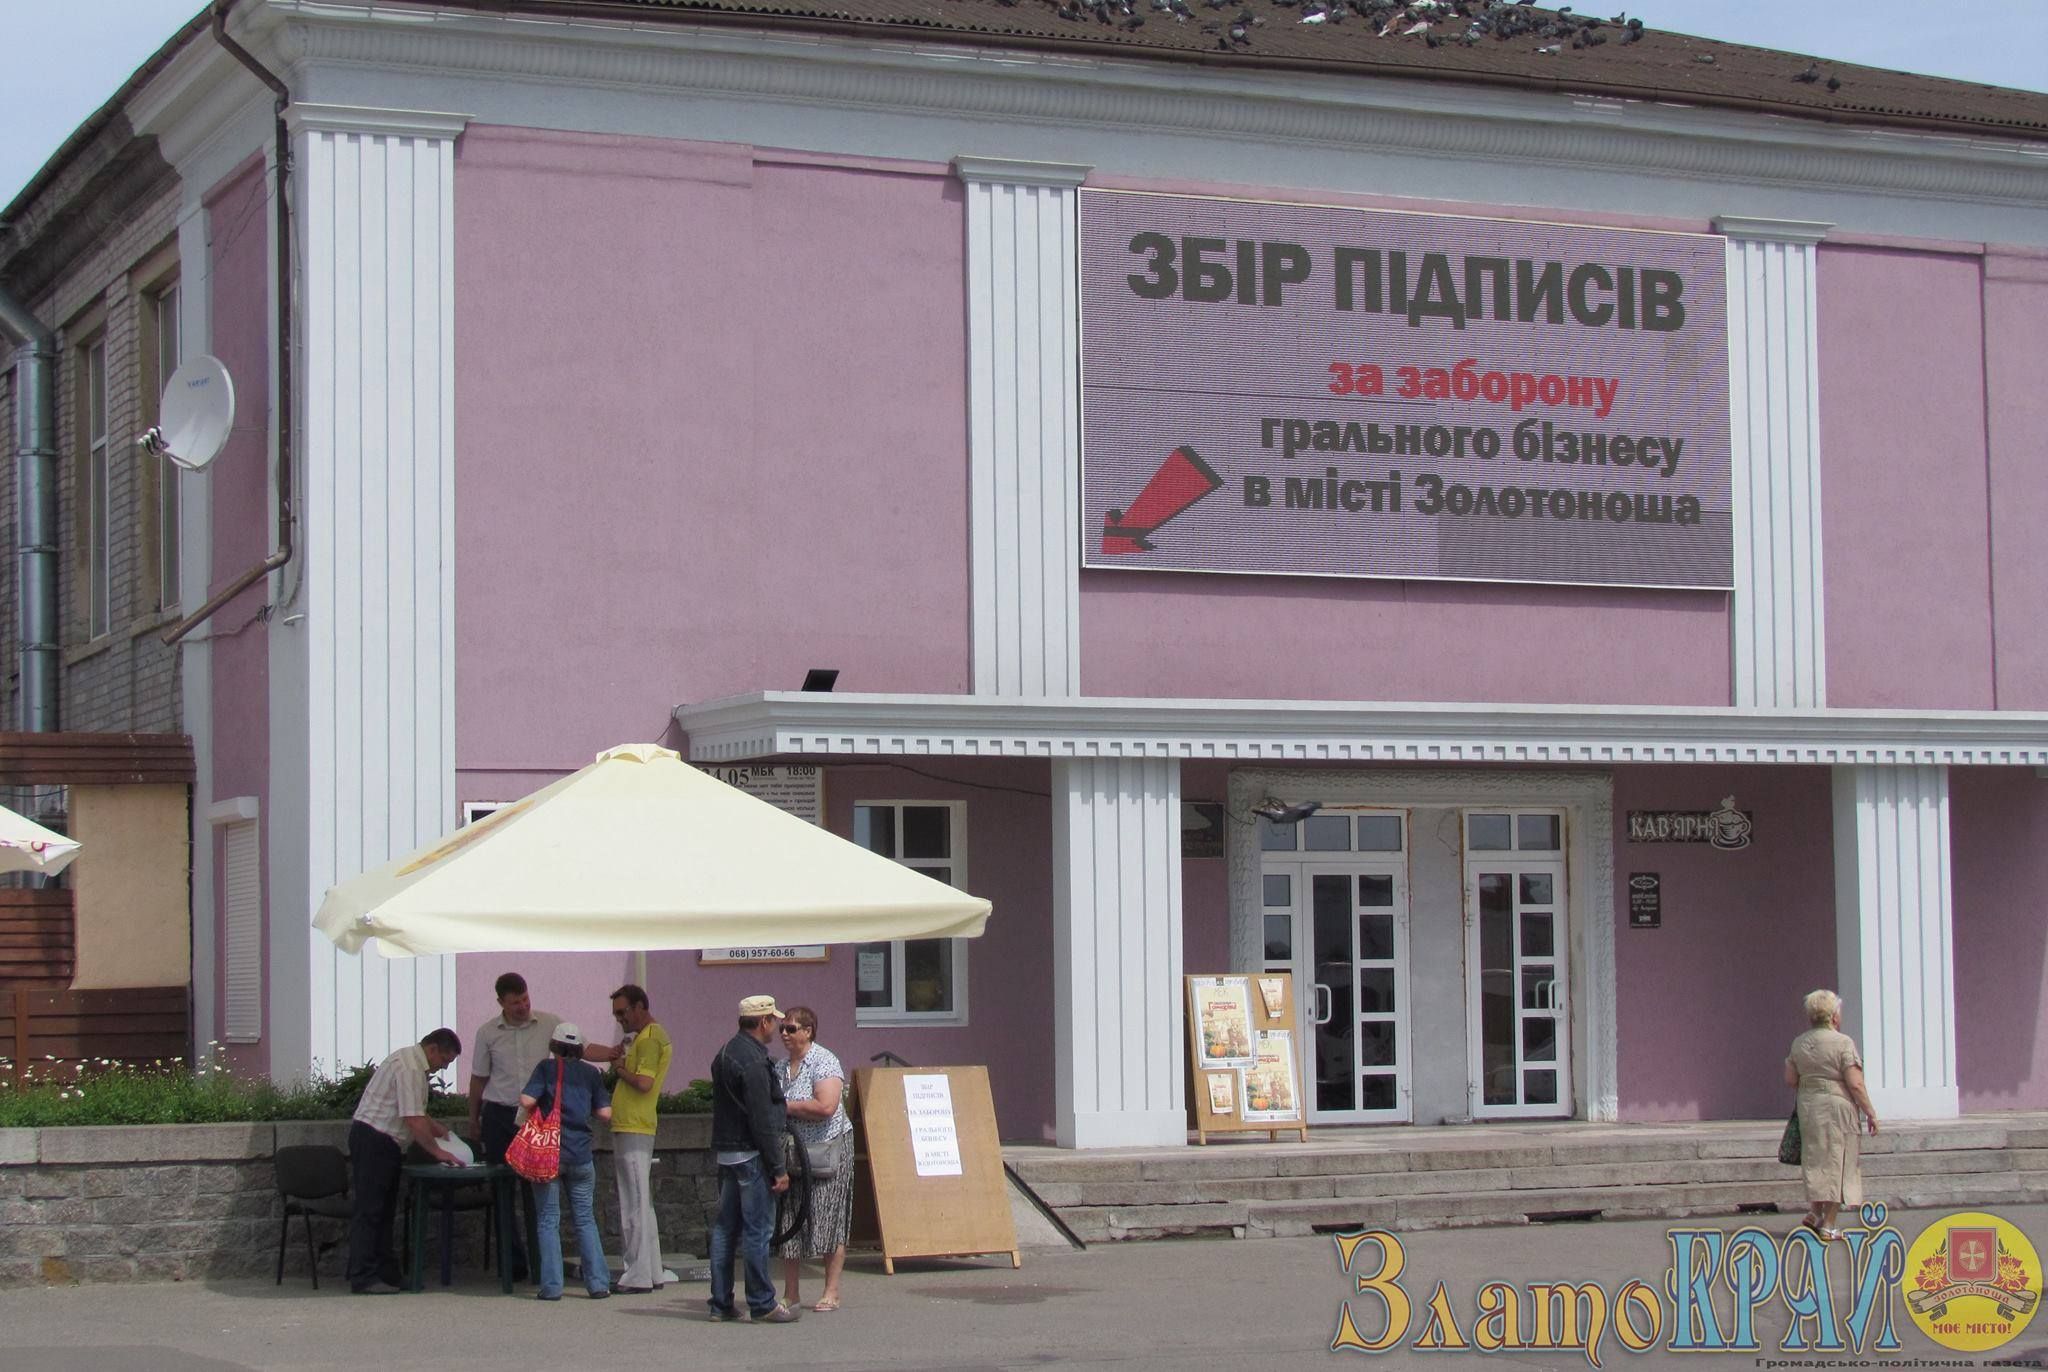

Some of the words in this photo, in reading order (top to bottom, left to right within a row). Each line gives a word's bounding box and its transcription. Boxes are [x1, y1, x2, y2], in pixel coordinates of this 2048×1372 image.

[1126, 231, 1312, 307] ЗБІР
[1333, 246, 1686, 332] ПІДПИСІВ
[1328, 361, 1384, 396] за
[1396, 358, 1619, 419] заборону
[1260, 416, 1500, 460] грального
[1512, 418, 1684, 477] бізнесу
[1243, 474, 1271, 507] в
[1284, 467, 1402, 513] місті
[1413, 474, 1702, 526] Золотоноша
[751, 766, 775, 776] МБК
[786, 766, 816, 776] 18:00
[751, 948, 796, 959] 957-60-66
